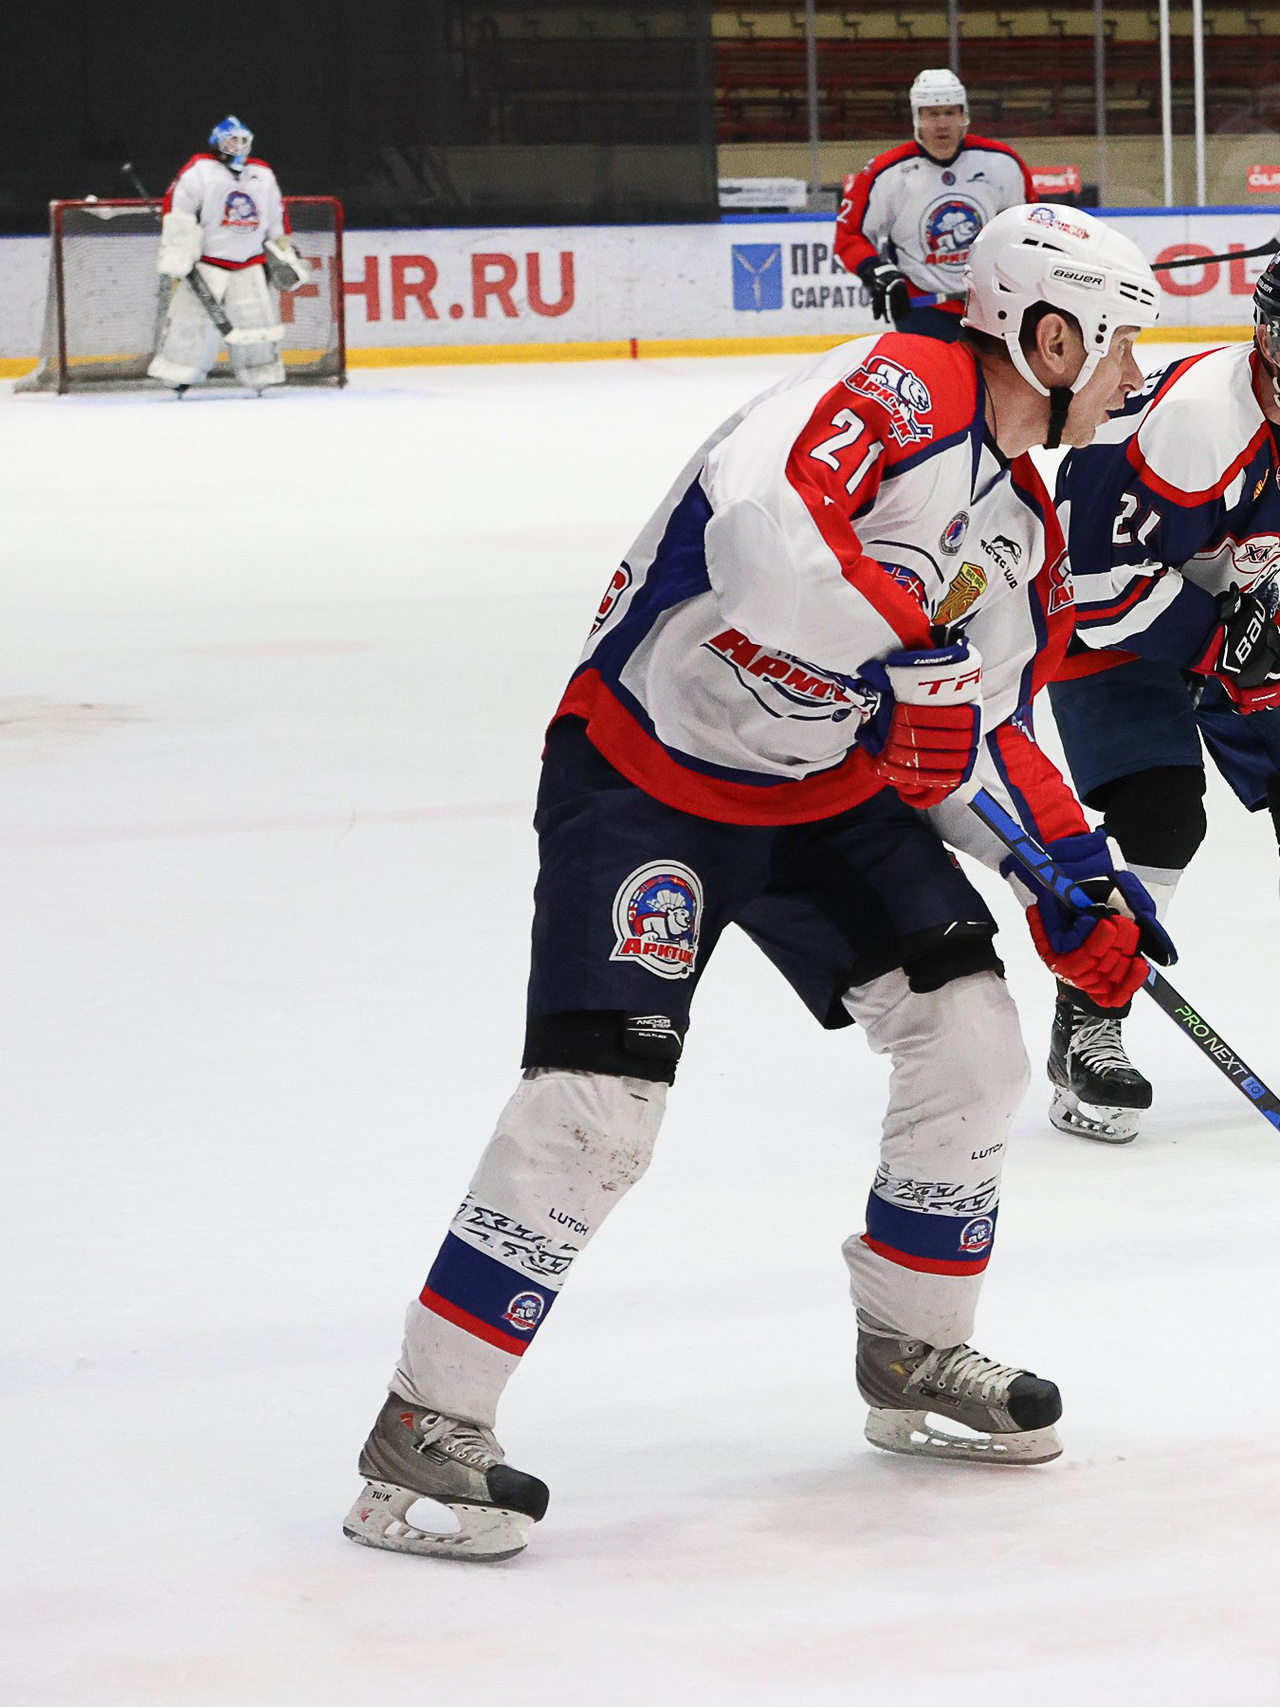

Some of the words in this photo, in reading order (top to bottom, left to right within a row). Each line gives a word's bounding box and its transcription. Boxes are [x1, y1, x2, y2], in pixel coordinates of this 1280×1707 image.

[810, 407, 885, 495] 21
[1112, 492, 1162, 546] 21
[1174, 1005, 1210, 1037] PRO
[1203, 1037, 1249, 1076] NEXT
[549, 1208, 589, 1236] LUTCH
